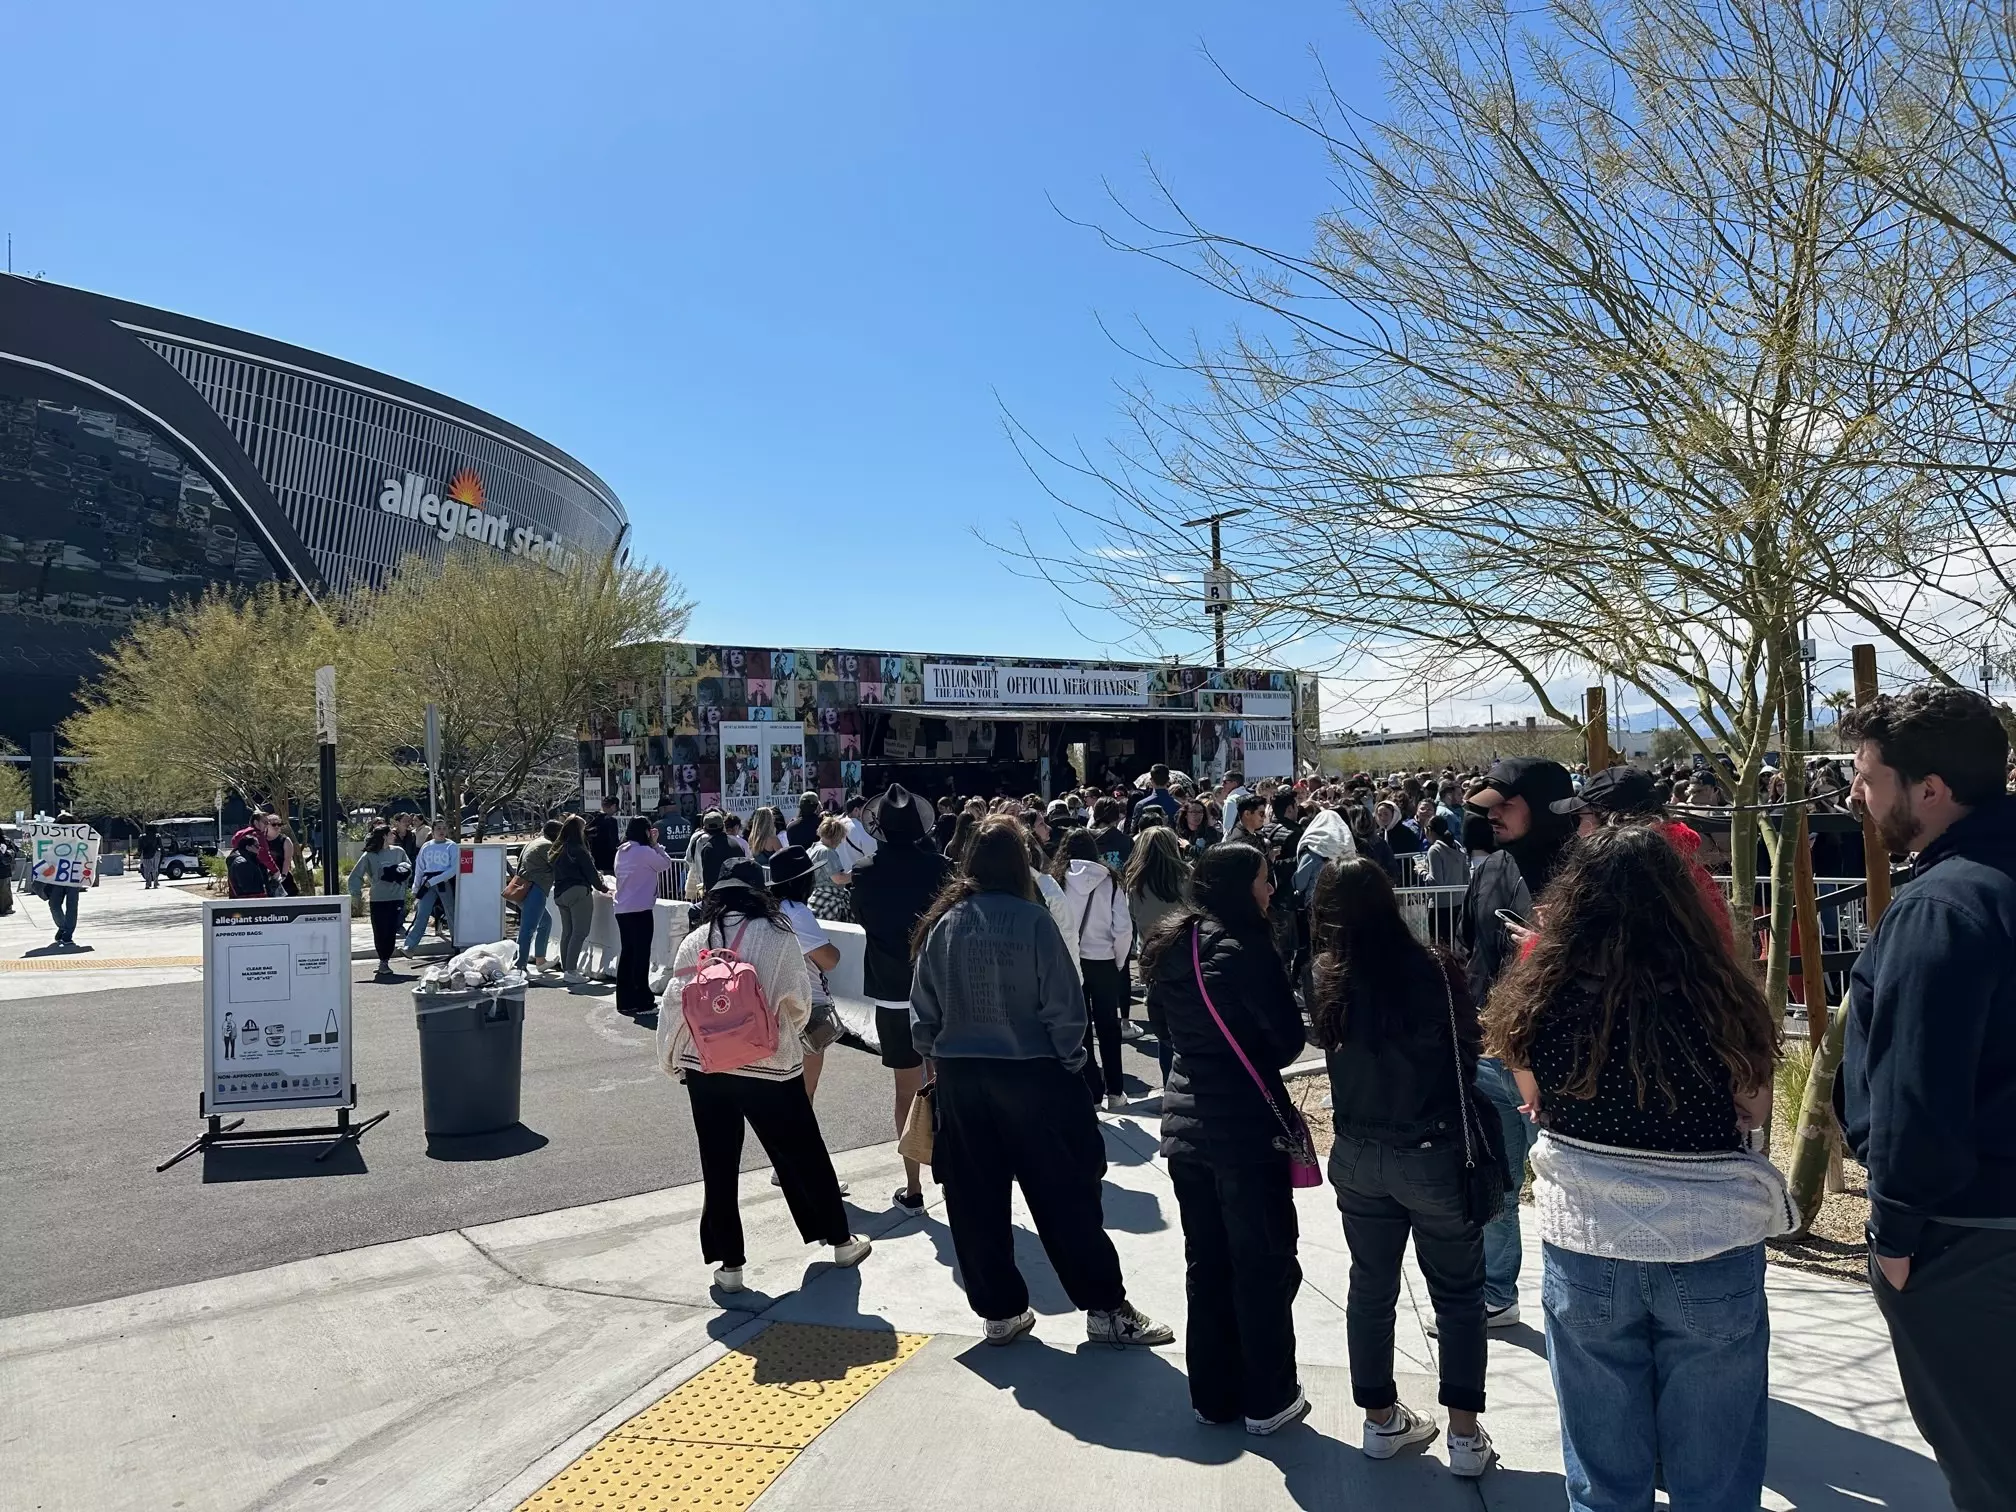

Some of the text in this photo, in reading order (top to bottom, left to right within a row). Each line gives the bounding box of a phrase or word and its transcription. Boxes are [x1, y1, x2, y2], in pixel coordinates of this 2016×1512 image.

[379, 473, 509, 549] allegiant
[1211, 587, 1220, 599] B
[1802, 647, 1809, 656] B
[933, 668, 999, 689] TAYLOR SWIFT
[1006, 675, 1140, 697] OFFICIAL MERCHANDISE
[934, 688, 999, 699] THE ERAS TOUR
[1244, 724, 1291, 742] TAYLOR SWIFT
[1245, 741, 1291, 751] THE ERAS TOUR
[37, 840, 89, 862] FOR
[460, 855, 473, 865] EXIT
[215, 914, 289, 925] allegiant stadium
[217, 1072, 263, 1080] NON-APPROVED
[1455, 1440, 1469, 1448] NIKE
